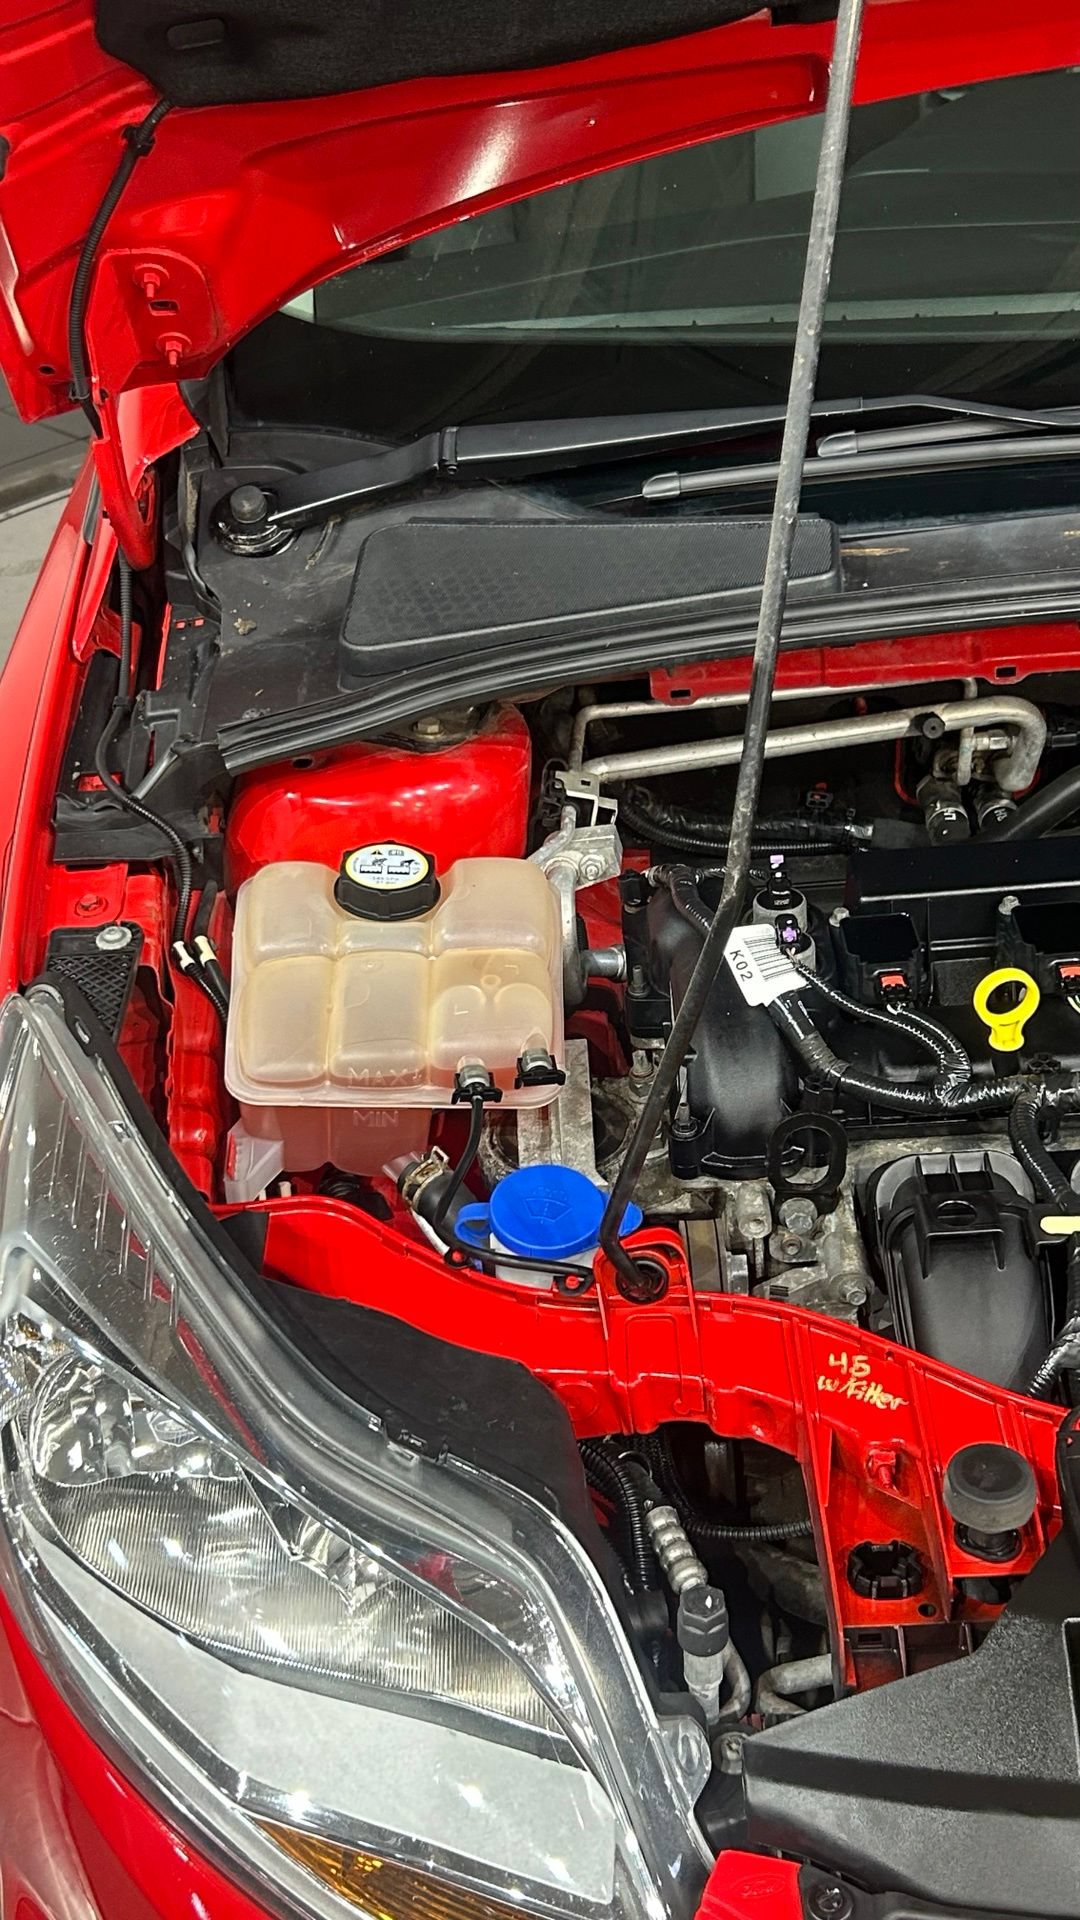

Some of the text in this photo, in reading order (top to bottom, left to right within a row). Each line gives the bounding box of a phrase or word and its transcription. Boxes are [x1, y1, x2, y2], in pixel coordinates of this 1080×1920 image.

[730, 949, 753, 982] K02
[349, 1066, 408, 1086] MAX
[353, 1110, 399, 1128] MIN
[828, 1352, 870, 1376] 45
